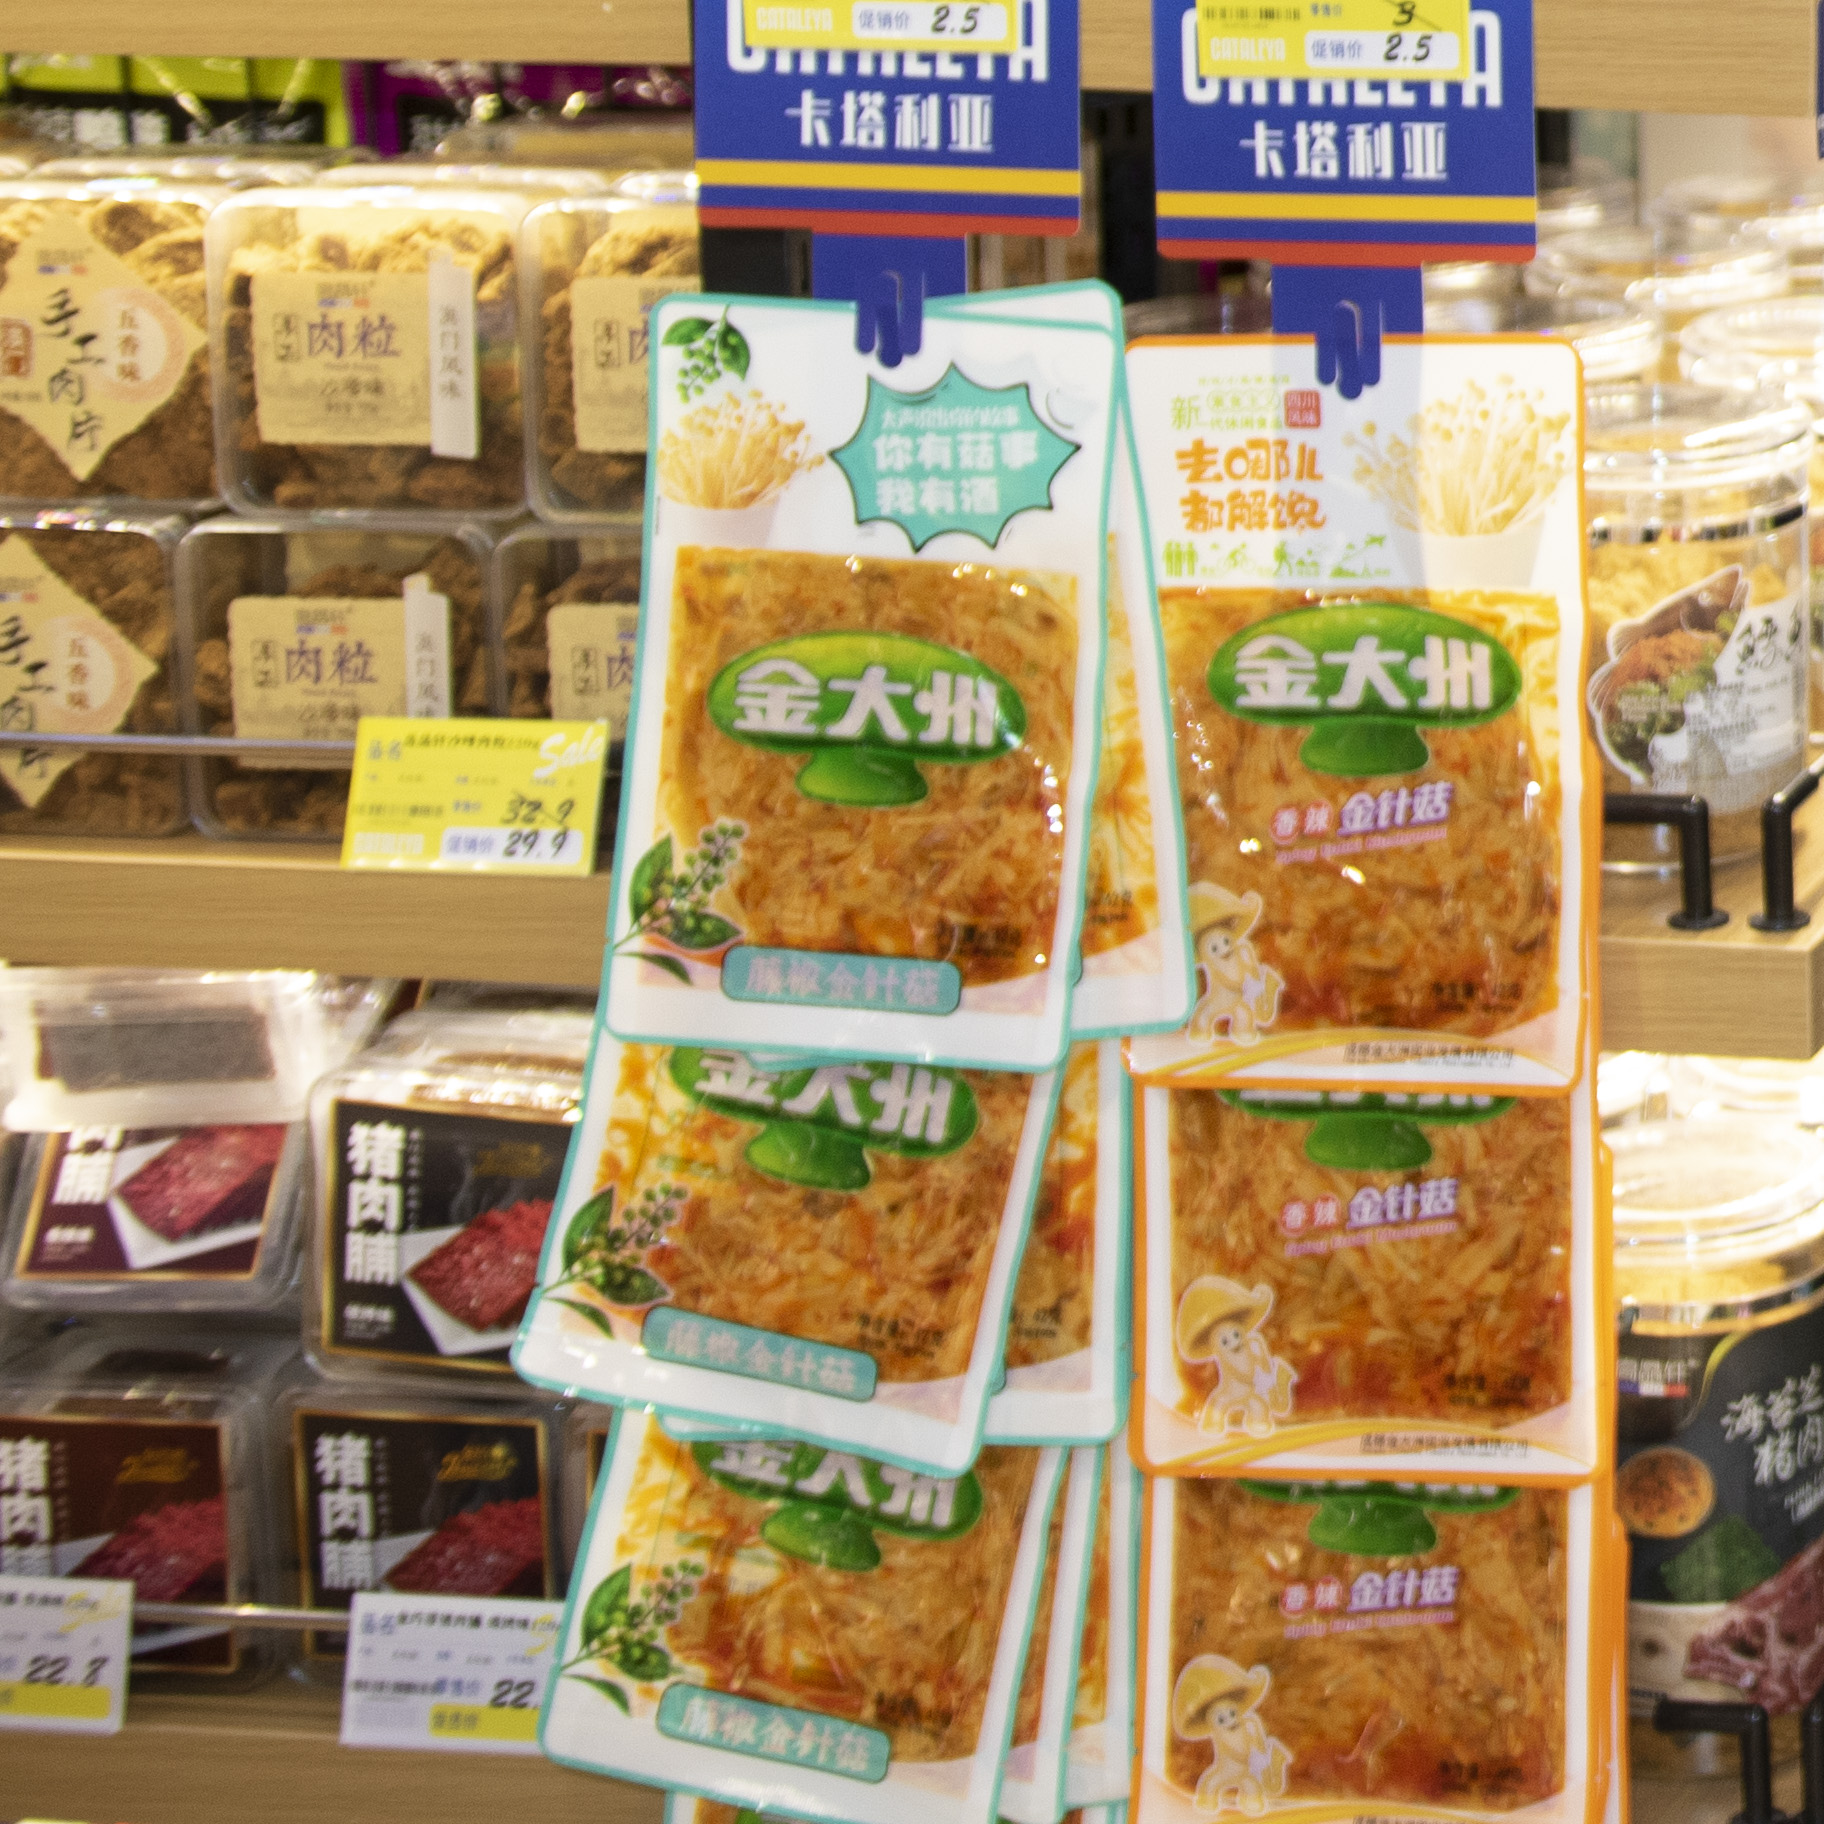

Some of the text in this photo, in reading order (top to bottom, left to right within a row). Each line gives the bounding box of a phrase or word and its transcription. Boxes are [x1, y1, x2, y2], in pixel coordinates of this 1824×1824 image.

[858, 5, 981, 34] 促销价 2.5
[1310, 34, 1433, 63] 促销价 2.5
[784, 89, 994, 154] 卡塔利亚
[1239, 119, 1448, 181] 卡塔利亚
[306, 312, 402, 361] 肉粒
[40, 286, 107, 453] 手工肉片
[1171, 393, 1202, 431] 新
[872, 429, 1040, 473] 你有菇事
[1174, 437, 1325, 485] 去哪儿
[875, 474, 1001, 517] 我有酒
[1178, 488, 1328, 534] 都解馋
[285, 639, 380, 685] 肉粒
[1234, 633, 1493, 710] 金大州
[732, 657, 1001, 748] 金大州
[532, 717, 608, 780] Sale
[1273, 781, 1456, 840] 香辣 金针菇
[503, 826, 572, 859] 29.9
[343, 1119, 405, 1286] 猪肉脯
[1282, 1176, 1459, 1236] 香辣 金针菇
[314, 1429, 378, 1592] 猪肉脯
[1347, 1564, 1460, 1614] 金针菇
[488, 1677, 542, 1709] 22.
